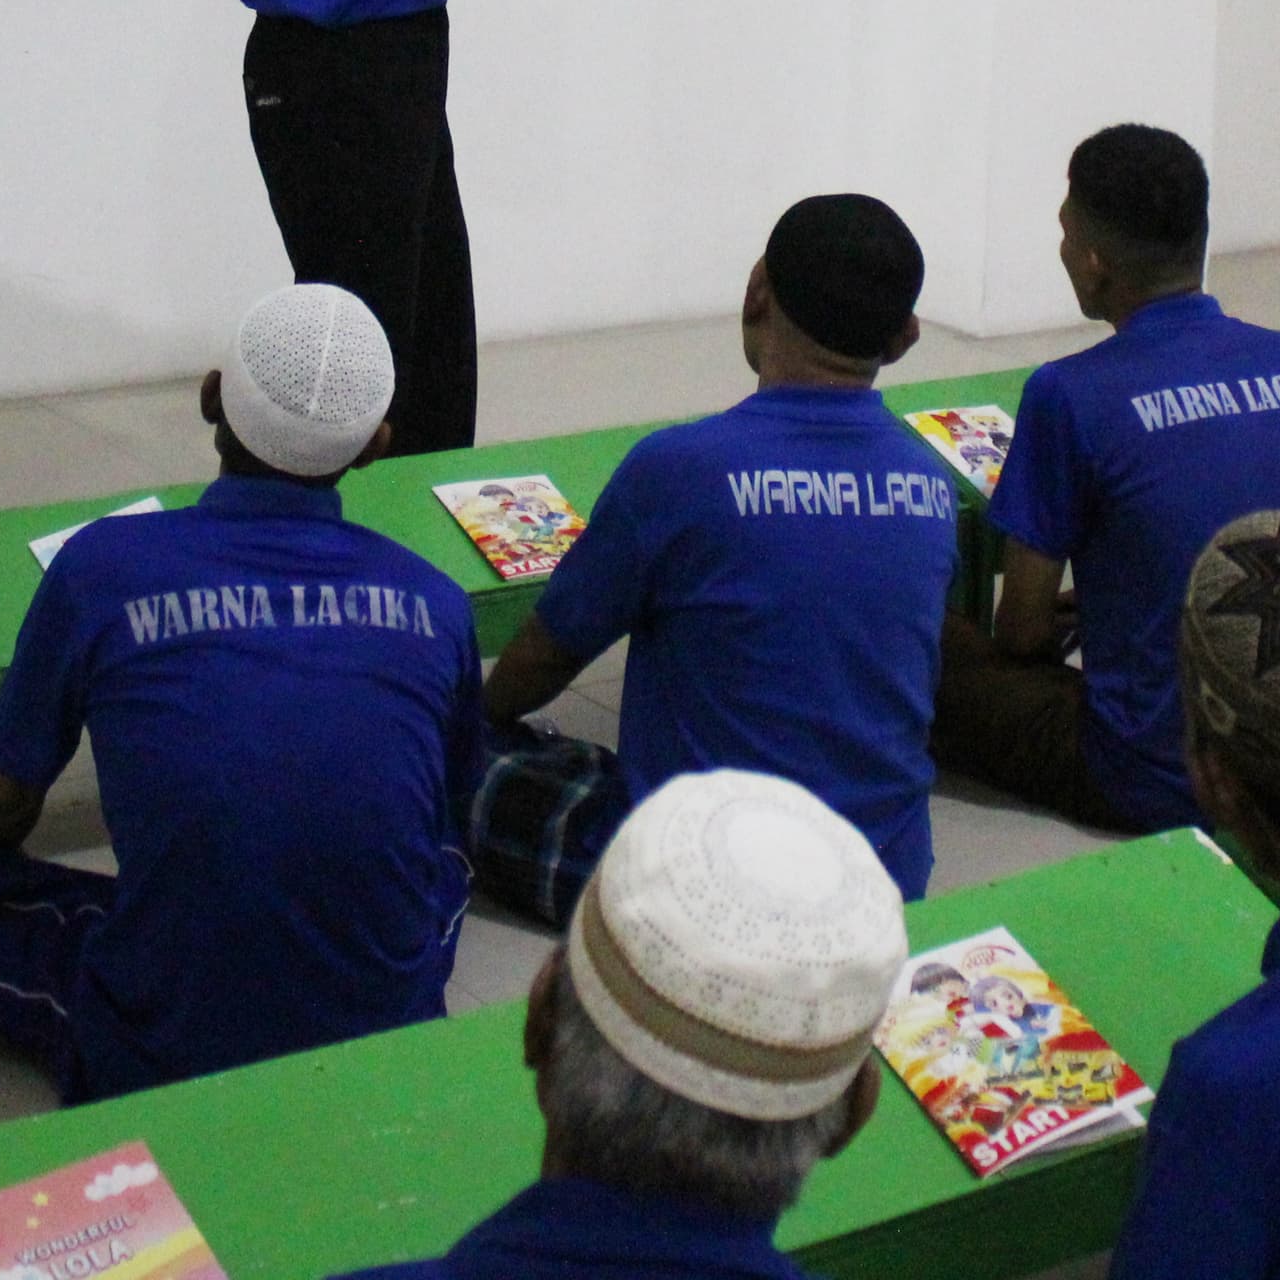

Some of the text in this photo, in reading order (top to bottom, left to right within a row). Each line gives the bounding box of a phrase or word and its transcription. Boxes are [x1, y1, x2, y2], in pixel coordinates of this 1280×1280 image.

[1131, 382, 1241, 432] WARNA
[728, 470, 953, 521] WARNA LACIKA
[124, 584, 435, 645] WARNA LACIKA
[972, 1106, 1070, 1168] START
[15, 1216, 137, 1265] WONDERFUL
[49, 1239, 135, 1280] LOLA
